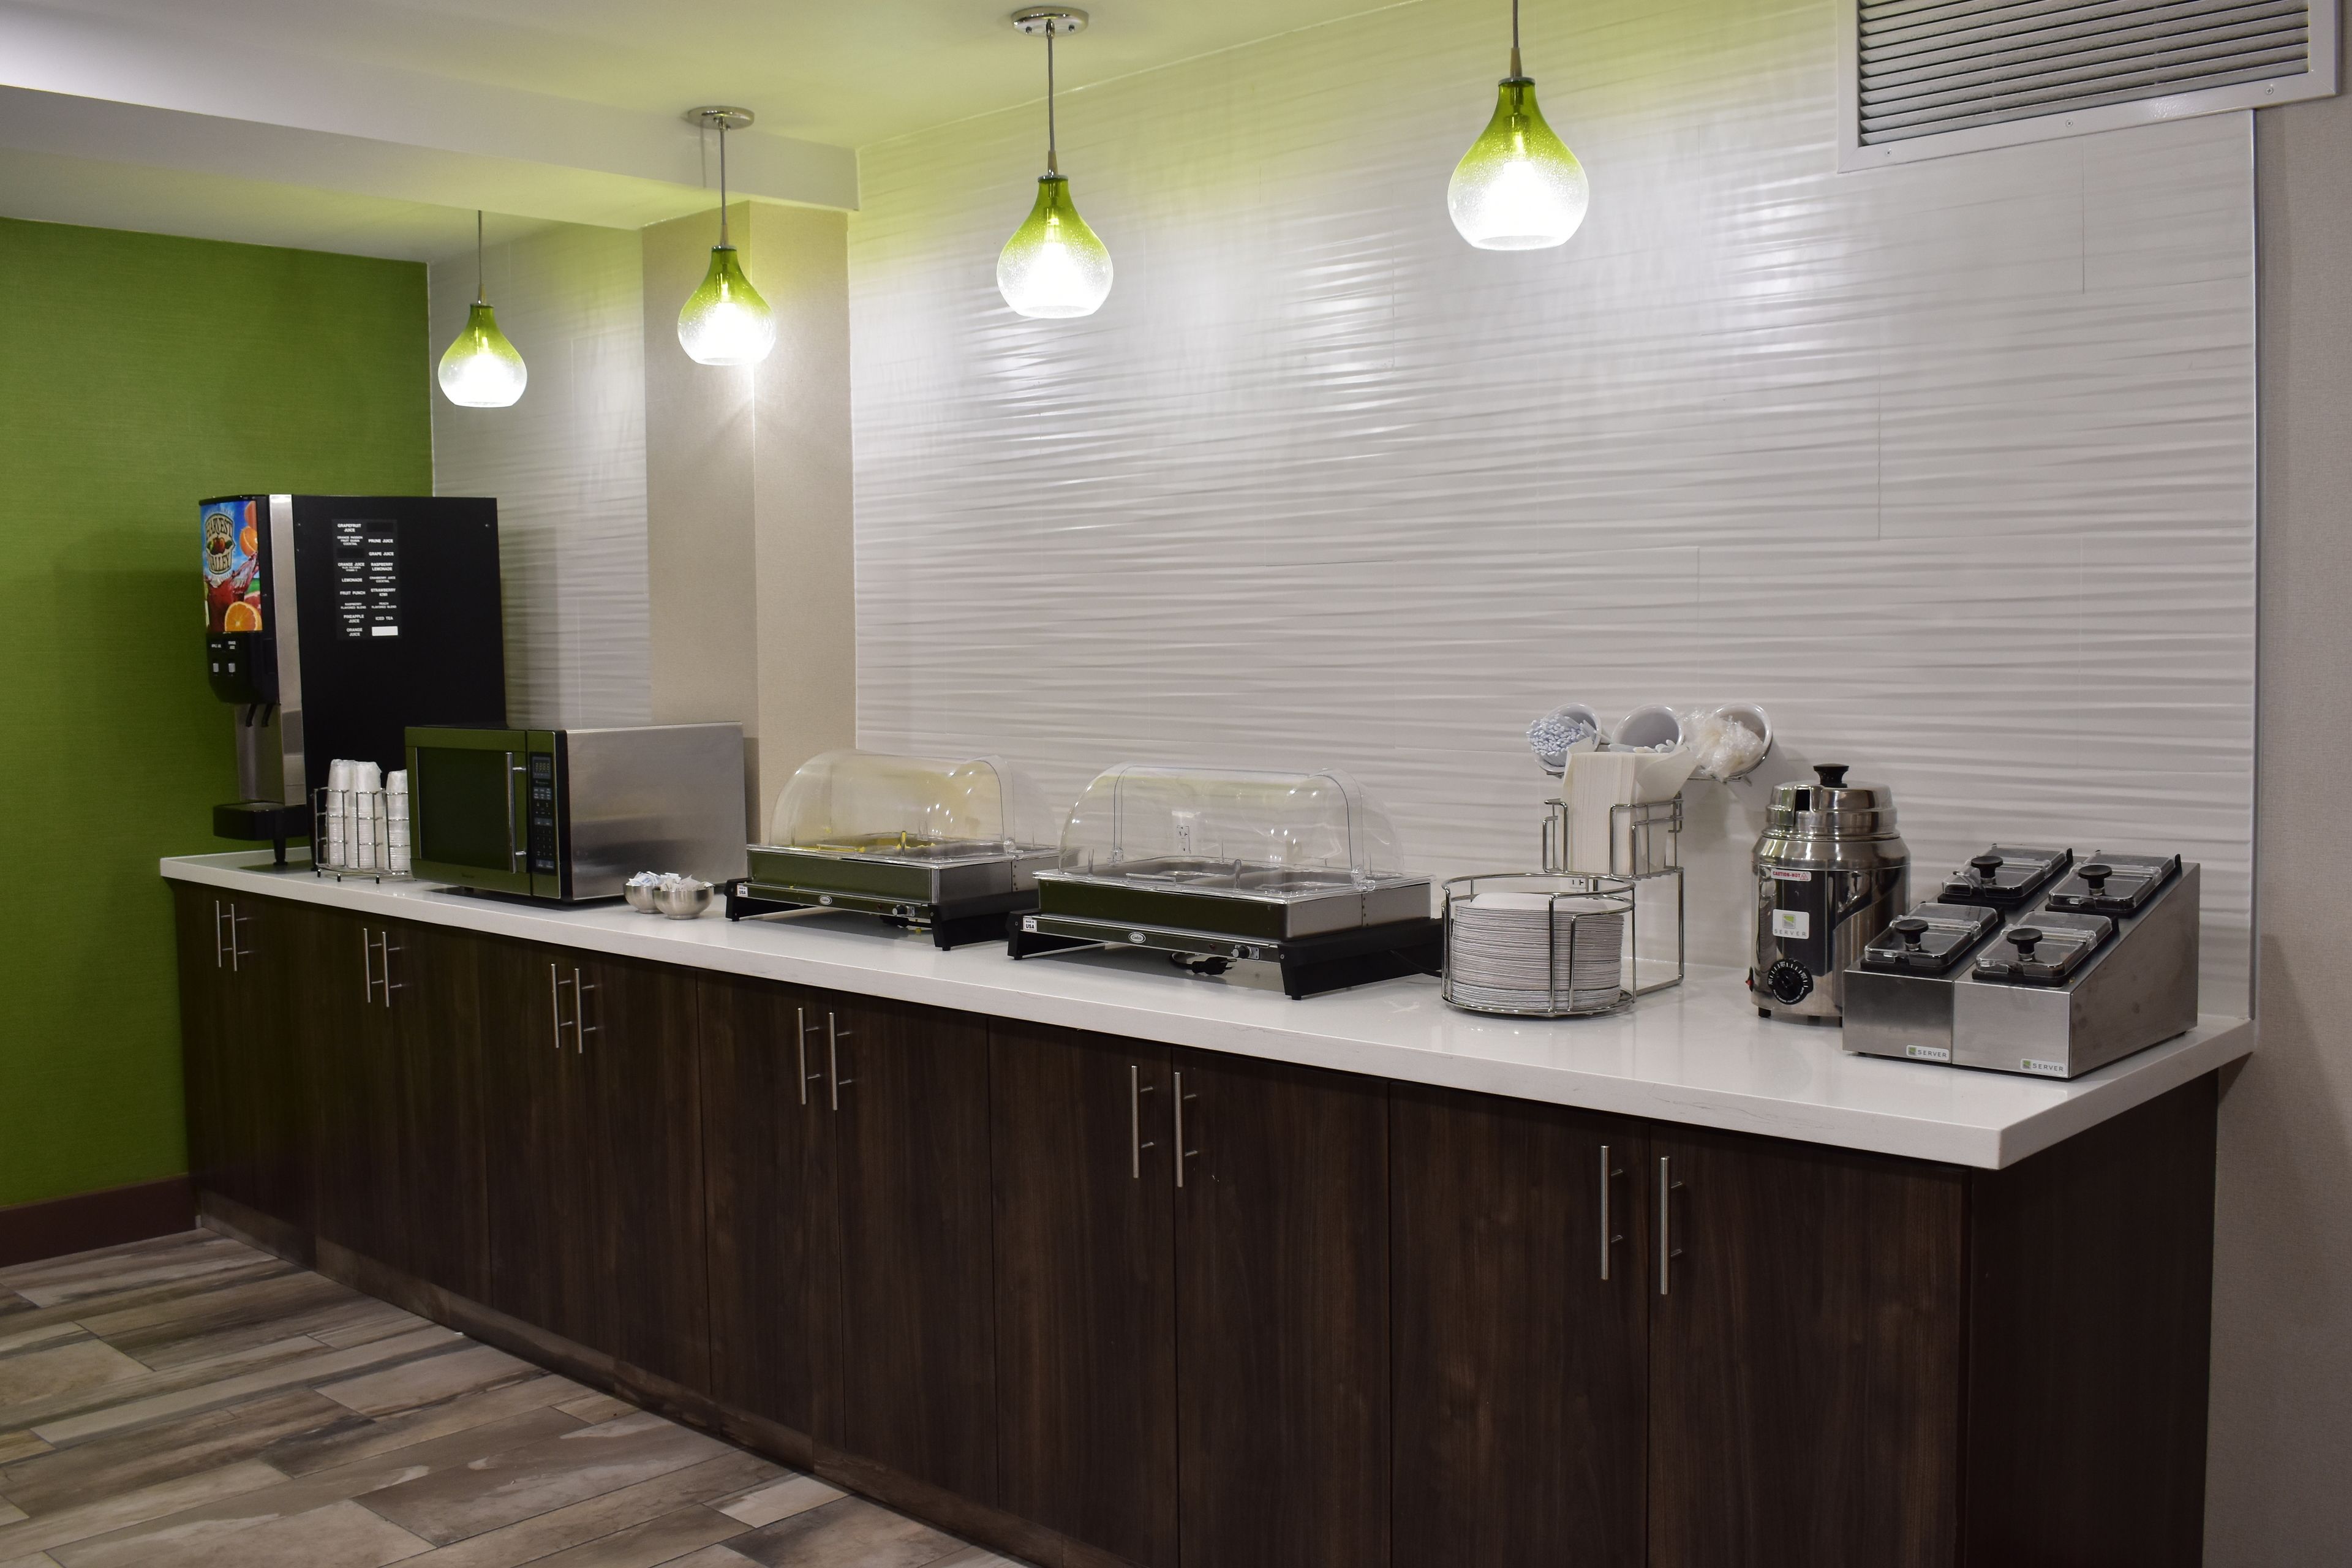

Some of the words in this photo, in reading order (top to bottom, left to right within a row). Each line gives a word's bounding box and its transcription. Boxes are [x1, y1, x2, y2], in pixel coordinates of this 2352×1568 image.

[205, 517, 232, 537] HARVEST
[208, 552, 230, 571] VALLEY
[1918, 1049, 1947, 1058] SERVER
[2033, 1063, 2064, 1072] SERVER
